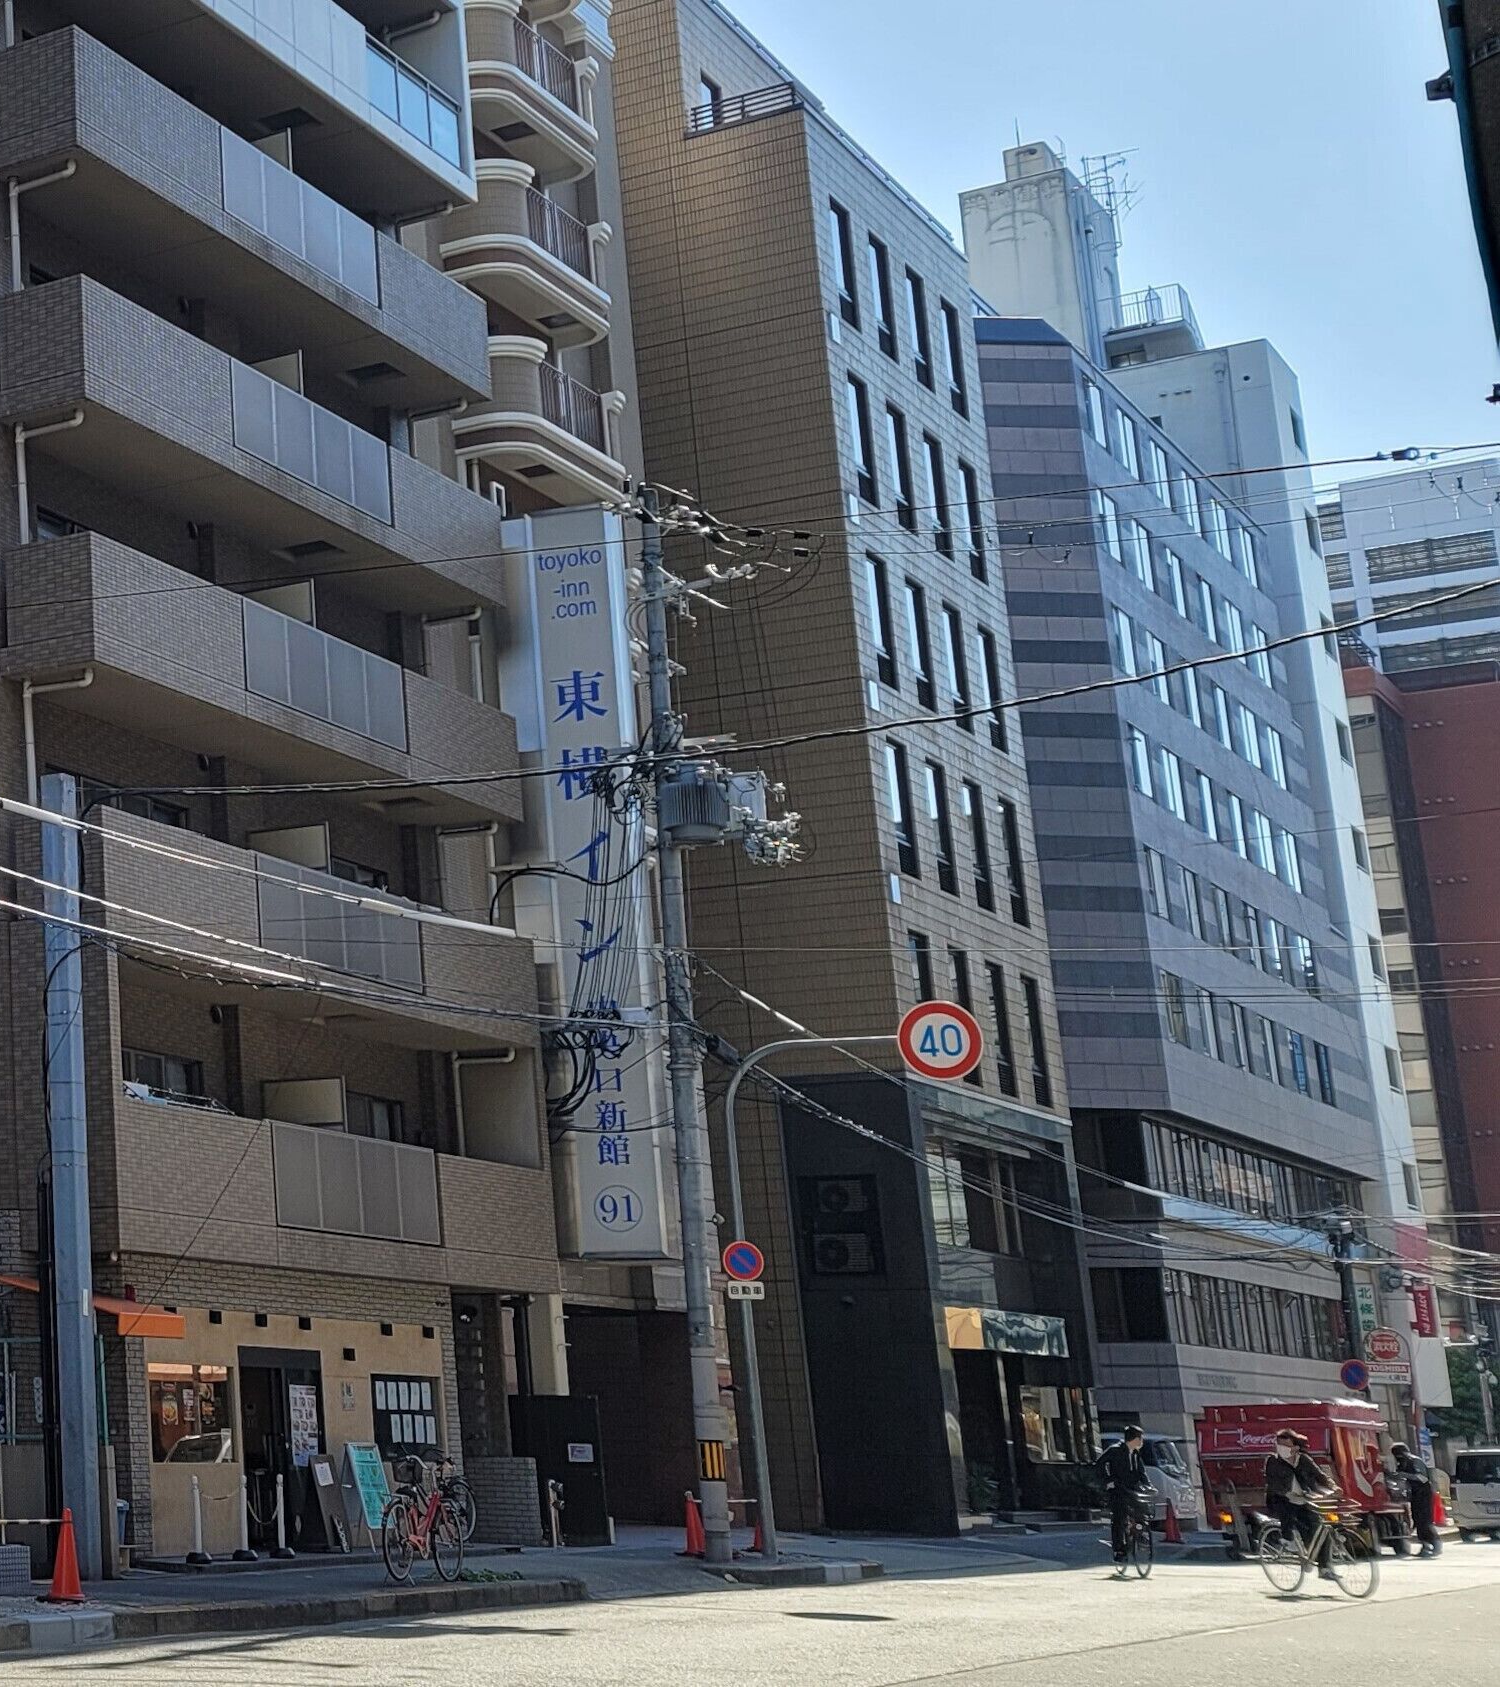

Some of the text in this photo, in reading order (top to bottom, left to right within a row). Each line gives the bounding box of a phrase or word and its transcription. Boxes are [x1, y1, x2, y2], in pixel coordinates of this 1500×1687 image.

[538, 547, 602, 573] toyoko
[553, 579, 590, 598] -inn
[551, 600, 596, 619] .com
[919, 1024, 963, 1057] 40
[591, 995, 630, 1166] 口新館
